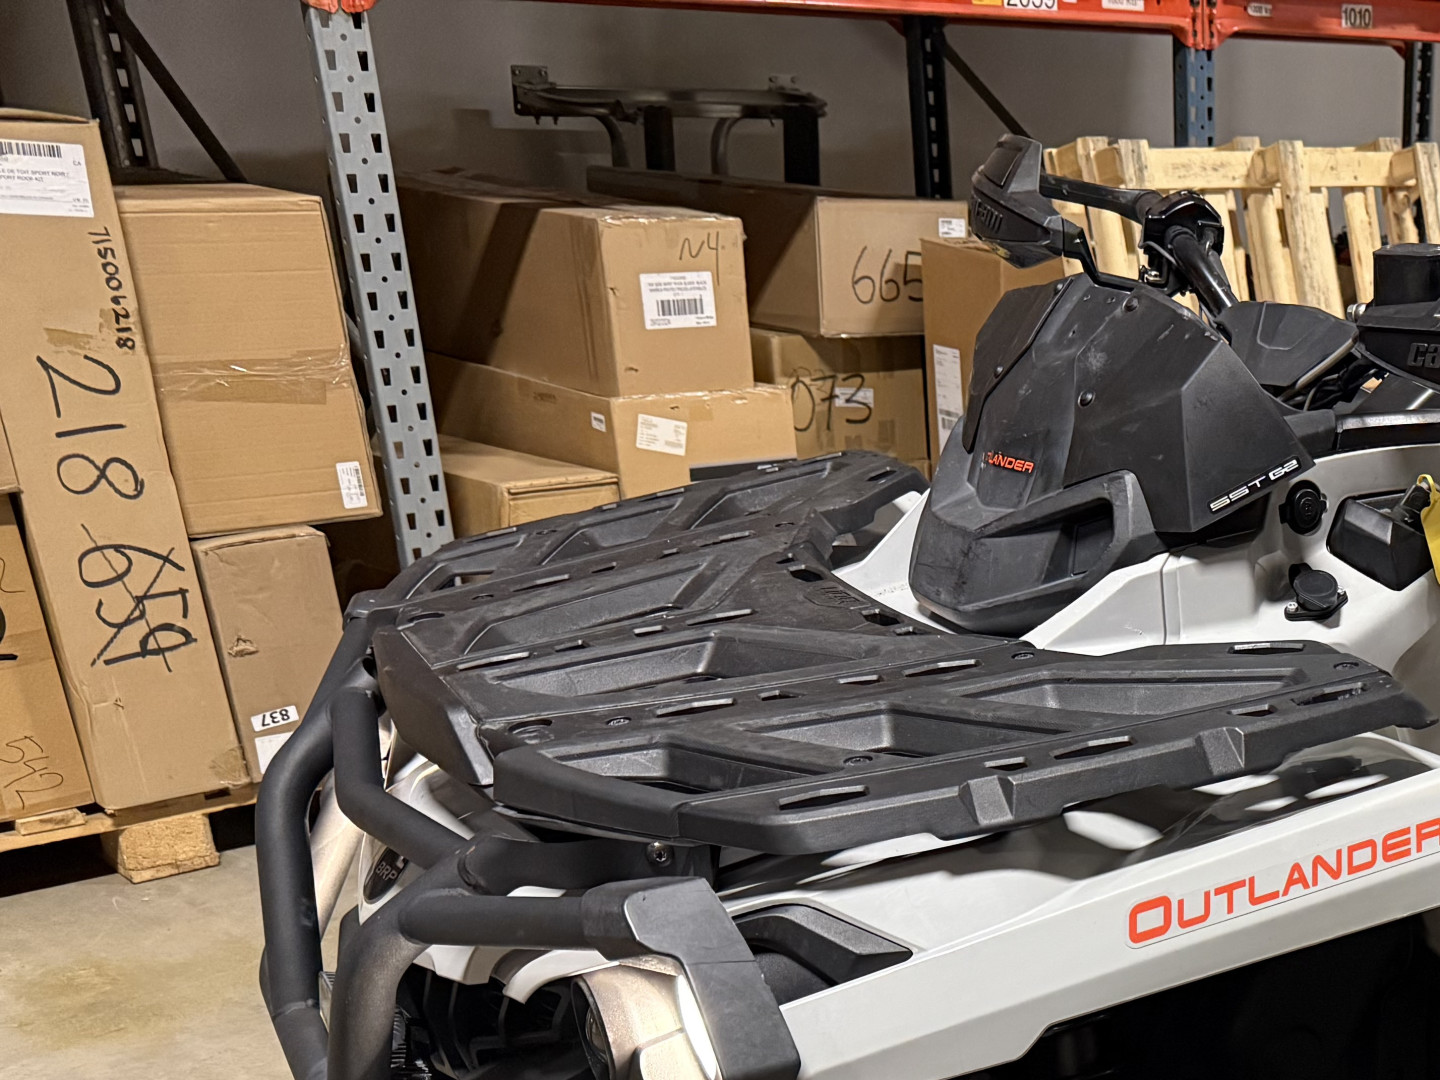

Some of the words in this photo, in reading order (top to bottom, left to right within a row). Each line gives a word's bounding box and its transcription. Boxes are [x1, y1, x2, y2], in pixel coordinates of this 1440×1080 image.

[1342, 6, 1371, 27] 1010
[987, 450, 1035, 474] LANDER
[261, 708, 291, 728] 837
[375, 861, 399, 881] BRP
